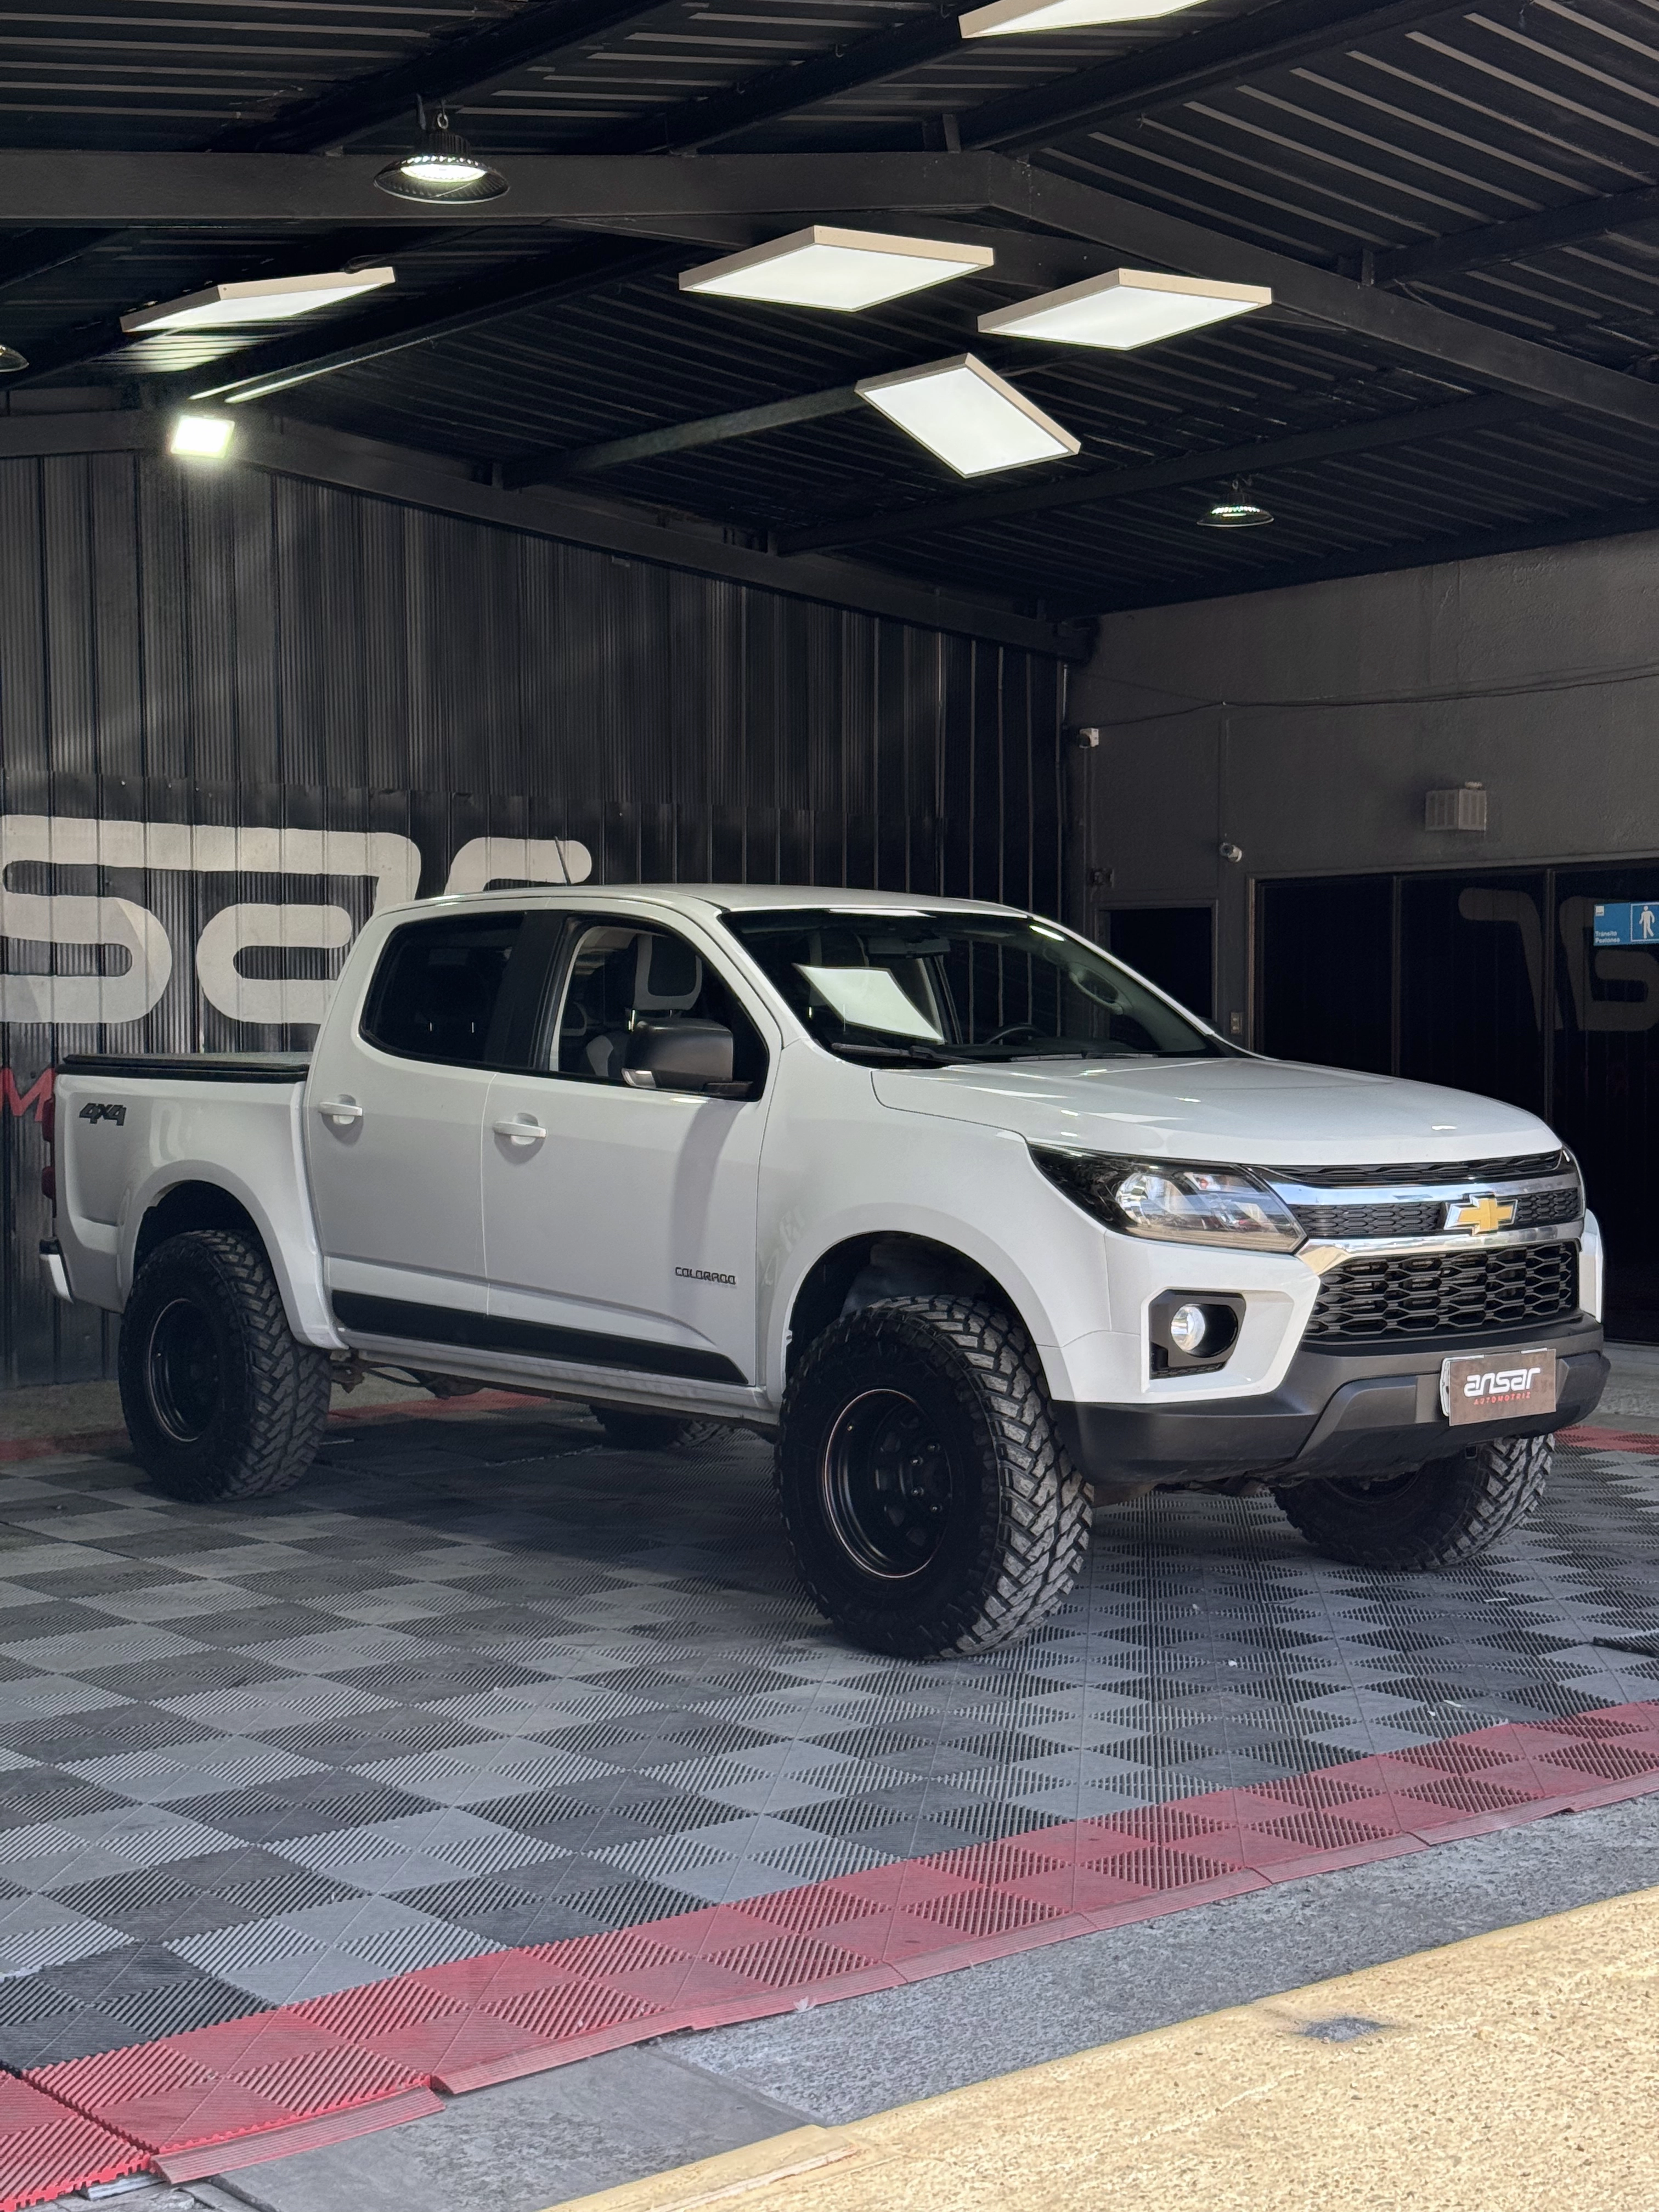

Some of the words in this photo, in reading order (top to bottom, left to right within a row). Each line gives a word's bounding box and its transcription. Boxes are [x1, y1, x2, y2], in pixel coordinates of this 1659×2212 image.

[675, 1267, 736, 1285] COLORADO
[1464, 1367, 1541, 1397] ansar
[1474, 1391, 1531, 1405] AUTOMOTRIZ
